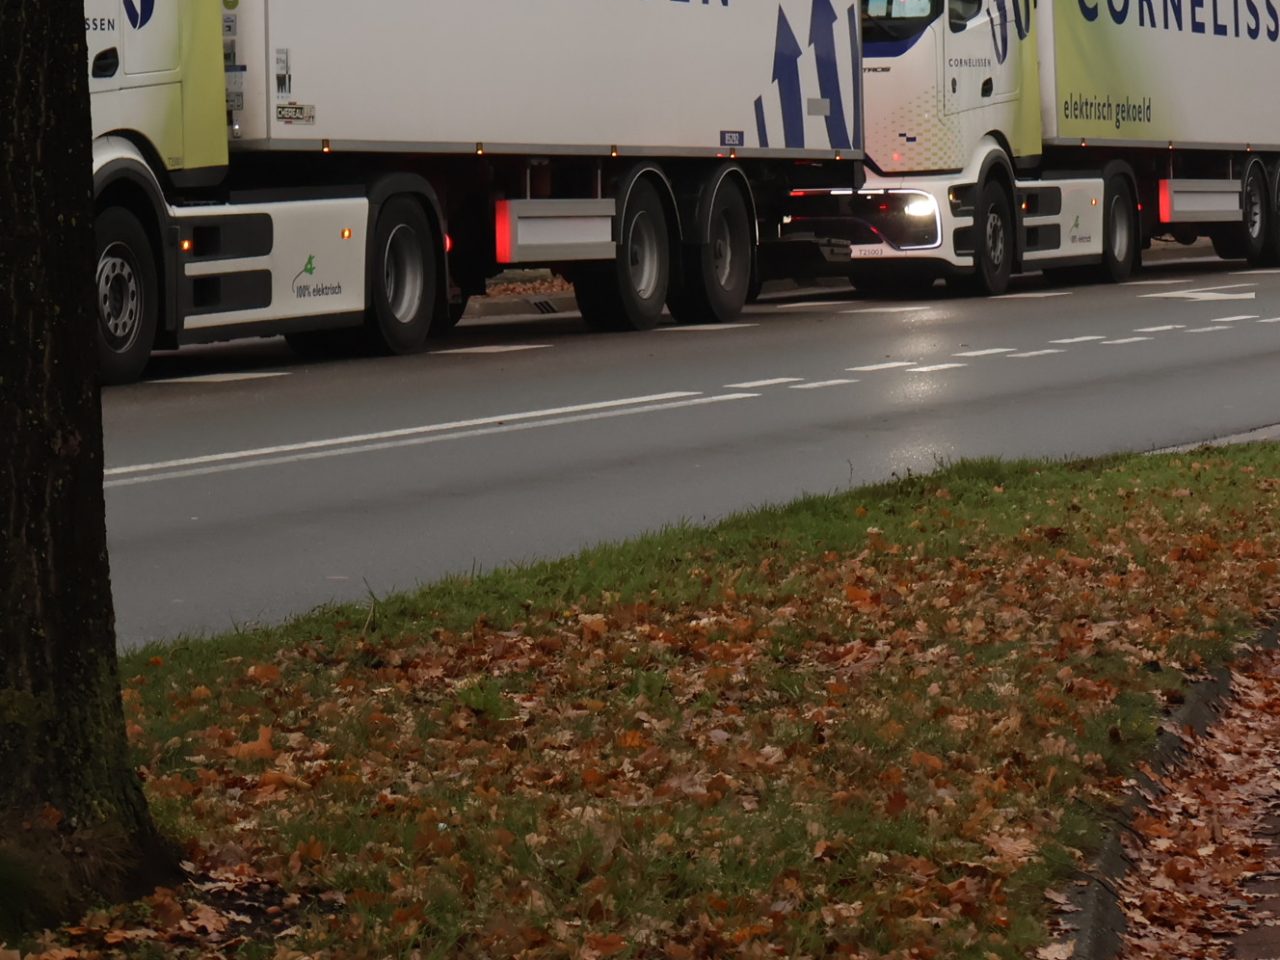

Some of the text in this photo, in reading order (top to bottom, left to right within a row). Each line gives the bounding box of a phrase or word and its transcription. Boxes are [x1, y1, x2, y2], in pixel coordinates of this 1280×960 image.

[948, 58, 992, 68] CORNELISSEN
[1064, 93, 1151, 129] elektrisch gekoeld
[296, 282, 342, 298] 100% elektrisch
